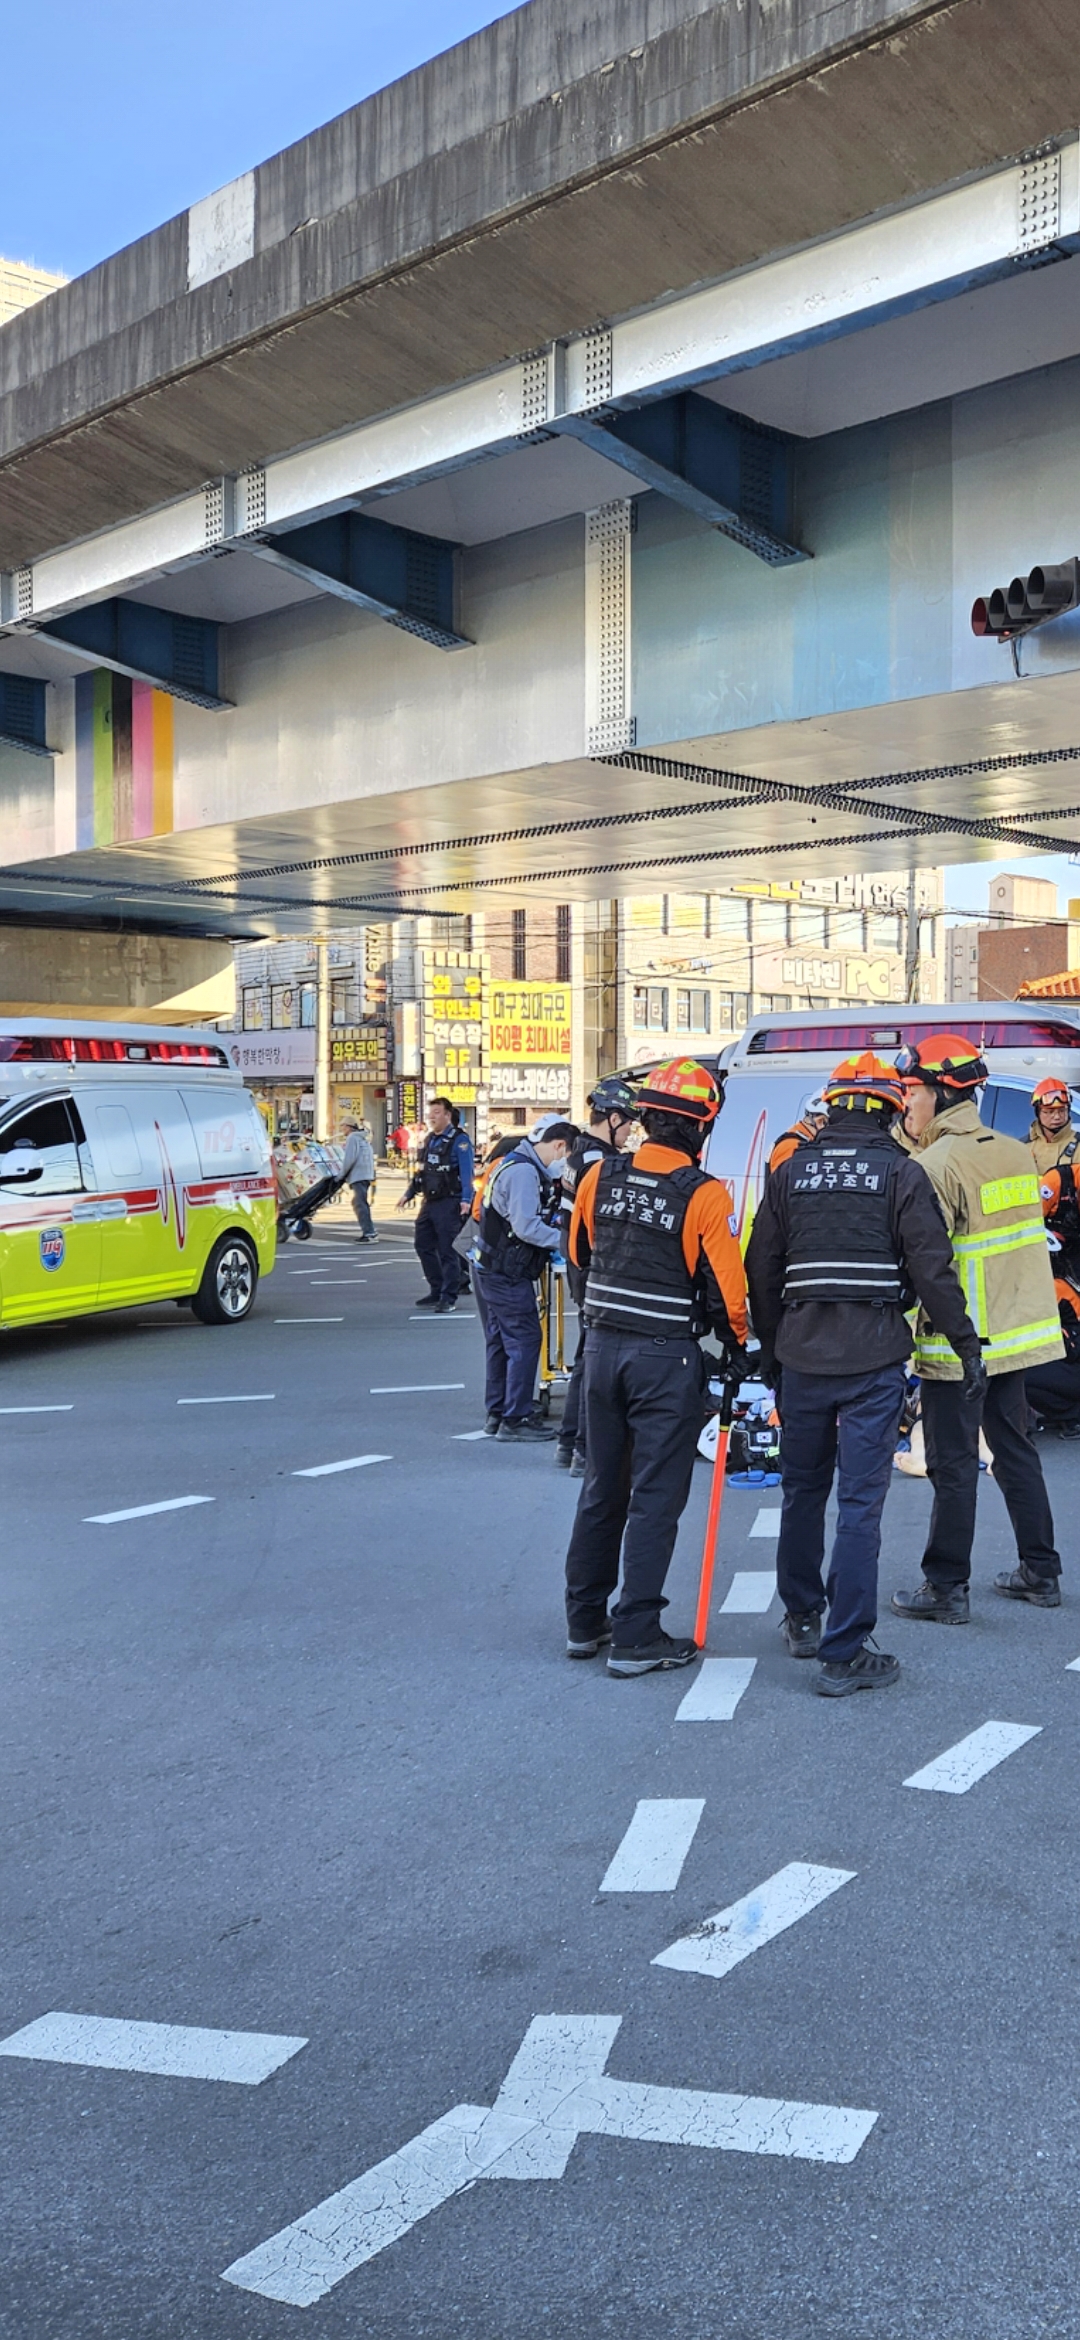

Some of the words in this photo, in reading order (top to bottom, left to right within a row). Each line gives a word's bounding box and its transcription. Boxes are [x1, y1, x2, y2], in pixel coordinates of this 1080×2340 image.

[782, 957, 841, 990] 비타민
[845, 957, 890, 997] PC
[433, 998, 482, 1020] 코인노래
[494, 992, 516, 1019] 대구
[521, 992, 565, 1022] 최대규모
[434, 1023, 482, 1045] 연습장
[490, 1025, 522, 1053] 150평
[526, 1025, 571, 1054] 최대시설
[242, 1047, 281, 1066] 행복한막창
[332, 1040, 378, 1061] 와우코인
[444, 1047, 471, 1067] 3F
[489, 1068, 570, 1101] 코인노래연습장
[203, 1120, 235, 1153] 119
[805, 1161, 869, 1175] 대구소방
[611, 1187, 667, 1211] 대구소방
[42, 1238, 62, 1258] 119
